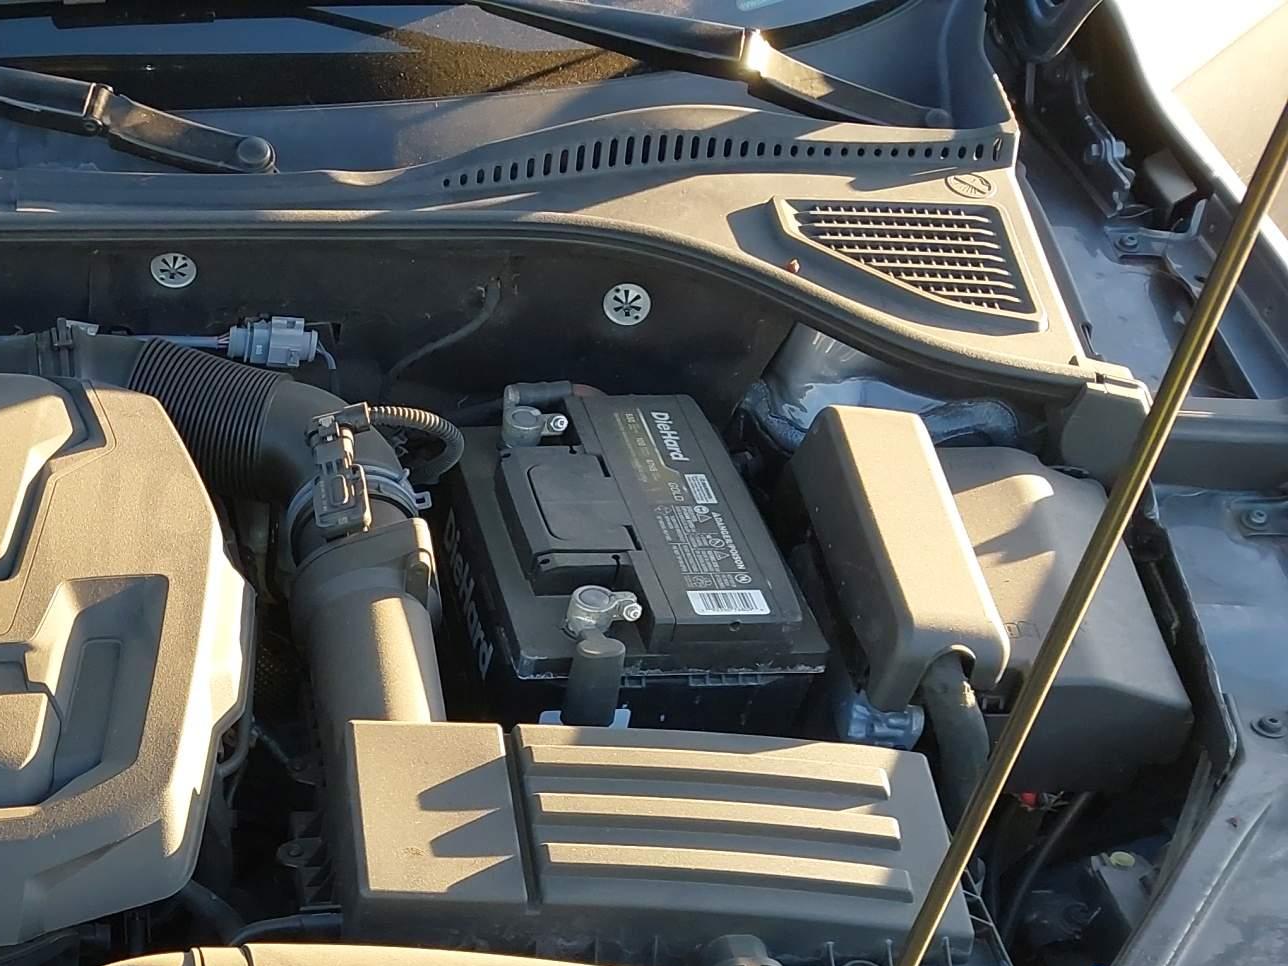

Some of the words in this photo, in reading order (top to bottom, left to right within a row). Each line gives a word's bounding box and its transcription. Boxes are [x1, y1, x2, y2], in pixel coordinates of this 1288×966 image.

[650, 410, 690, 461] DieHard
[667, 481, 684, 502] GOLD
[443, 508, 495, 680] DieHard
